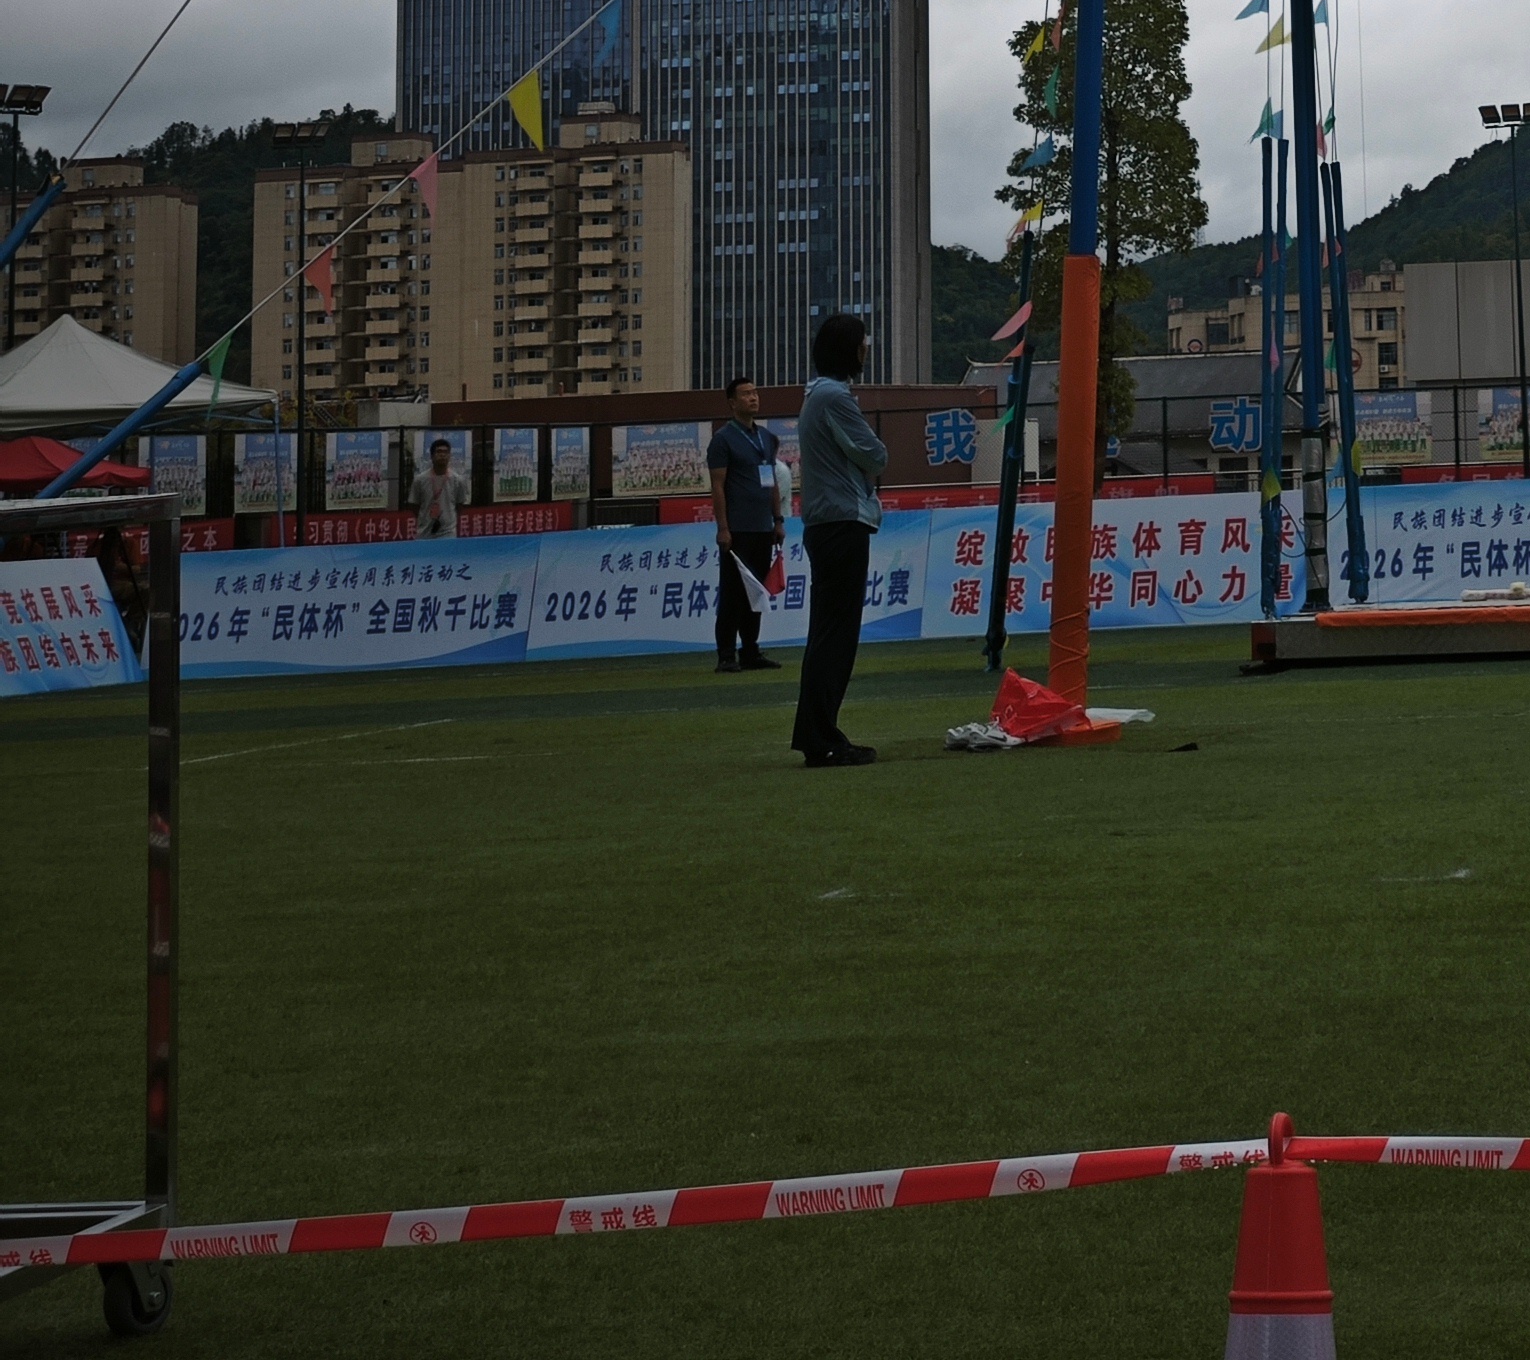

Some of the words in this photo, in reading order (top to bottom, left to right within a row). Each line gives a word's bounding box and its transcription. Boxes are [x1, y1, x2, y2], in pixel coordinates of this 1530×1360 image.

[925, 397, 1263, 466] 我动
[214, 563, 473, 597] 民族团结进步宣传周系列活动之
[179, 592, 517, 643] 026年“民体杯”全国秋千比赛
[775, 1187, 846, 1216] WARNING
[849, 1183, 885, 1210] LIMIT
[569, 1204, 657, 1232] 警戒线
[170, 1235, 240, 1259] WARNING
[242, 1233, 279, 1256] LIMIT
